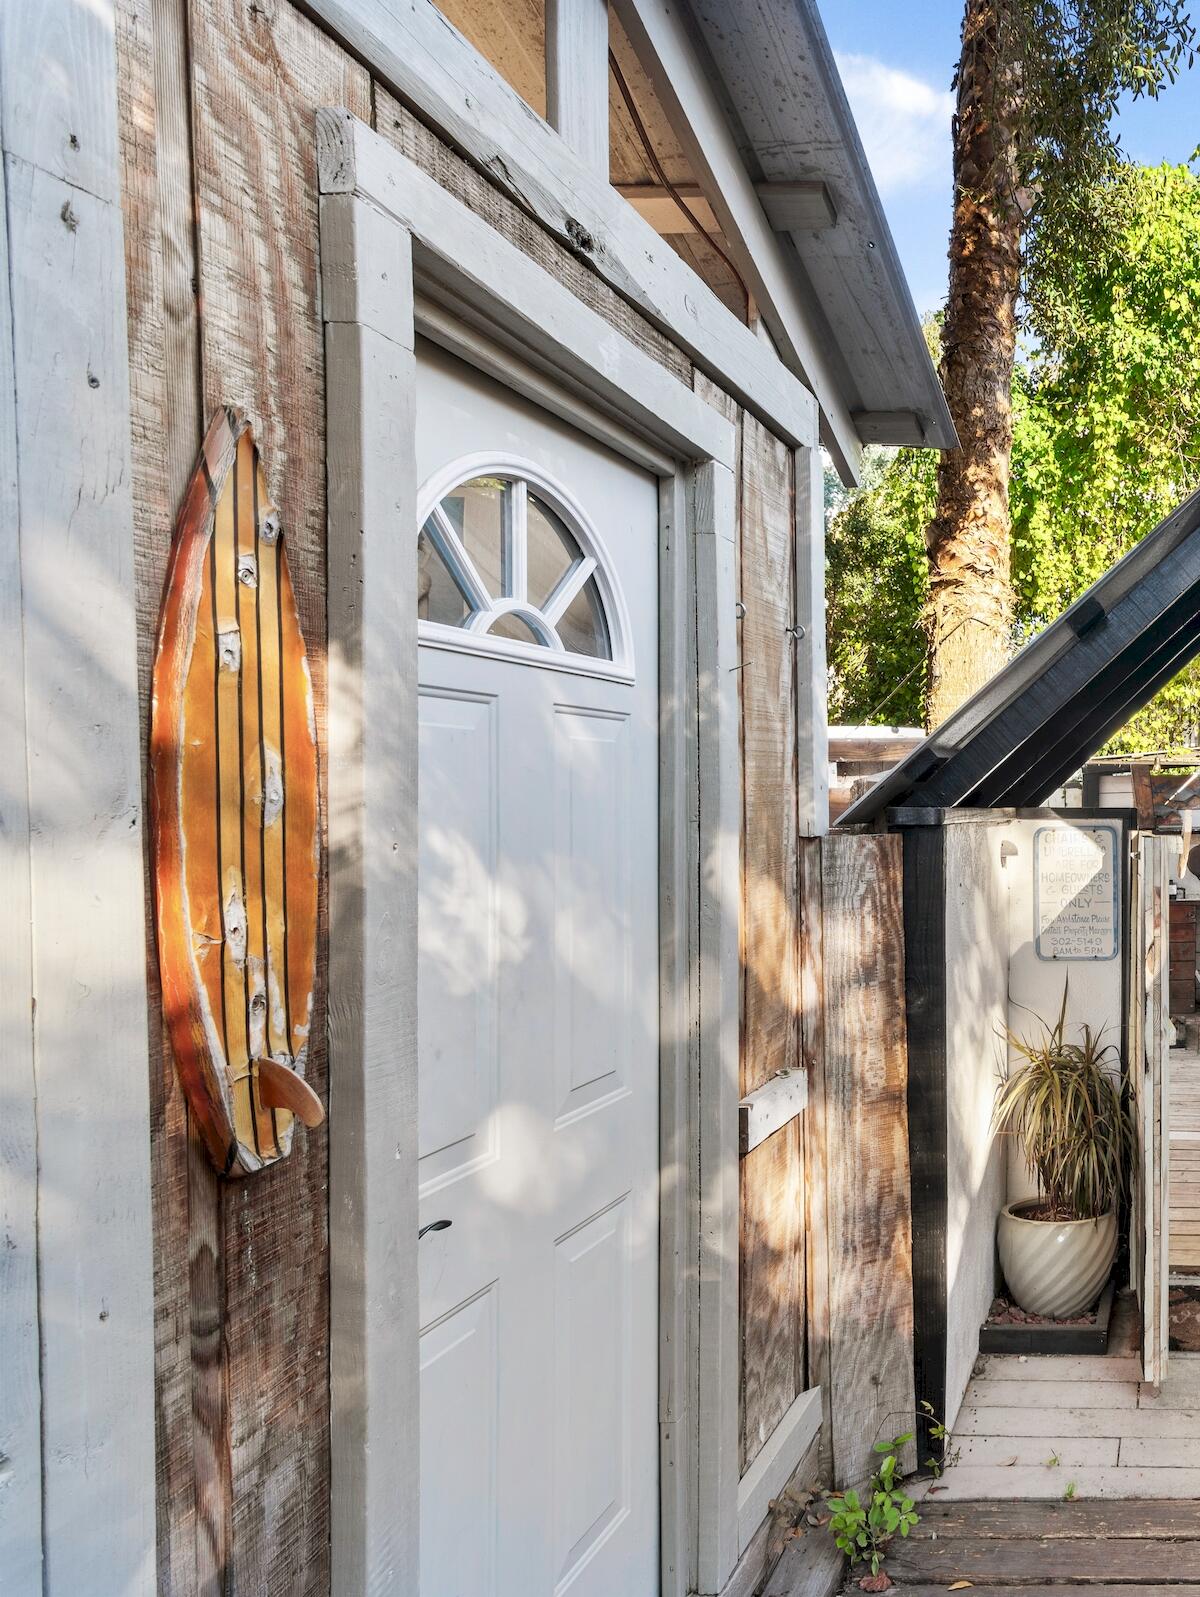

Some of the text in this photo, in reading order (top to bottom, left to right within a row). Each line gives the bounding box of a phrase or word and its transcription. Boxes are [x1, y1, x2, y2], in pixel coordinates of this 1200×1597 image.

[1044, 846, 1107, 857] UMBRELLS
[1041, 872, 1111, 884] HOMEOWNERS
[1061, 884, 1104, 895] GUESTS
[1060, 896, 1093, 909] ONLY
[1050, 937, 1103, 946] 302-5149
[1053, 946, 1072, 955] 8AM
